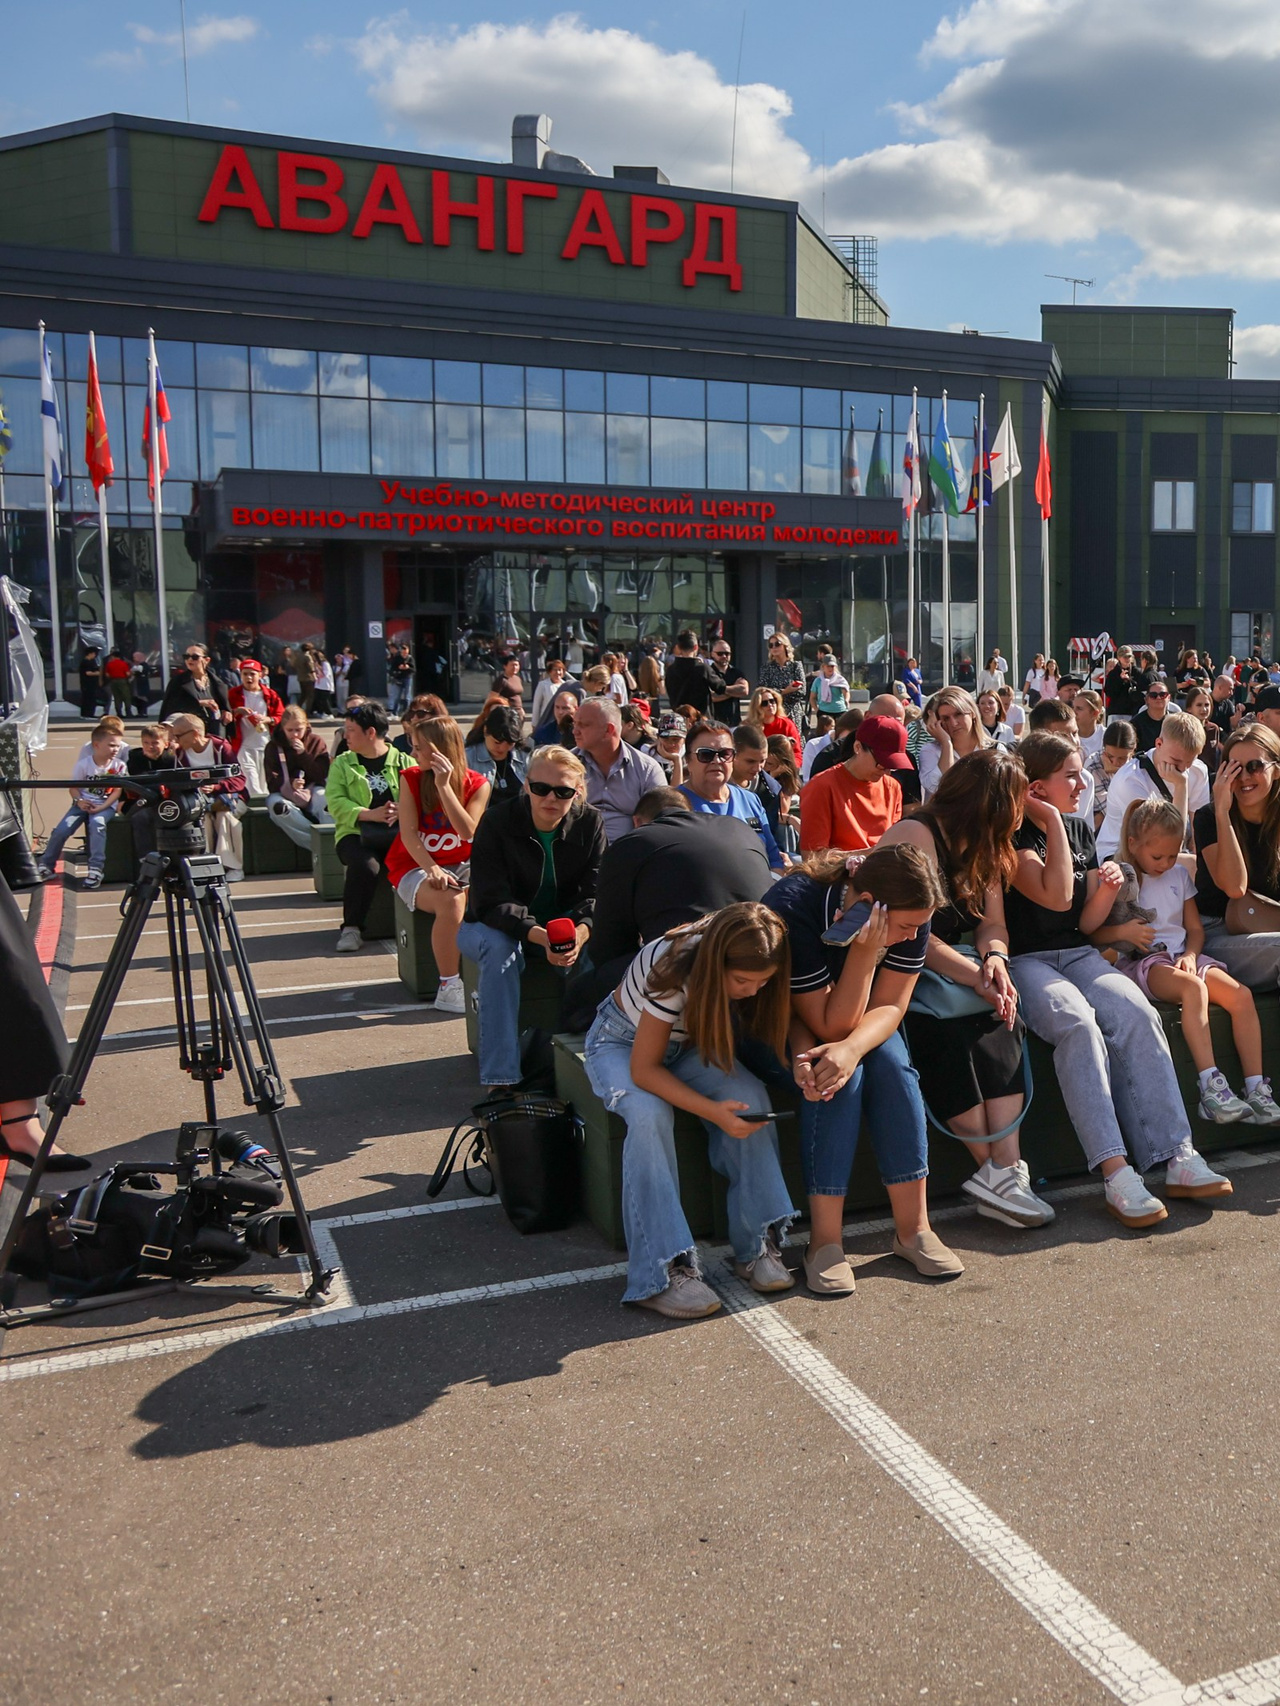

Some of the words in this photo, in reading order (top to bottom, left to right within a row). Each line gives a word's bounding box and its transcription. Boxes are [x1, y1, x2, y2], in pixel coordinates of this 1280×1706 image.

[198, 144, 743, 291] АВАНГАРД
[379, 480, 695, 516] Учебно-методический
[701, 499, 776, 522] центр
[231, 506, 604, 537] военно-патриотического
[612, 519, 766, 542] воспитания
[773, 525, 898, 546] молодежи
